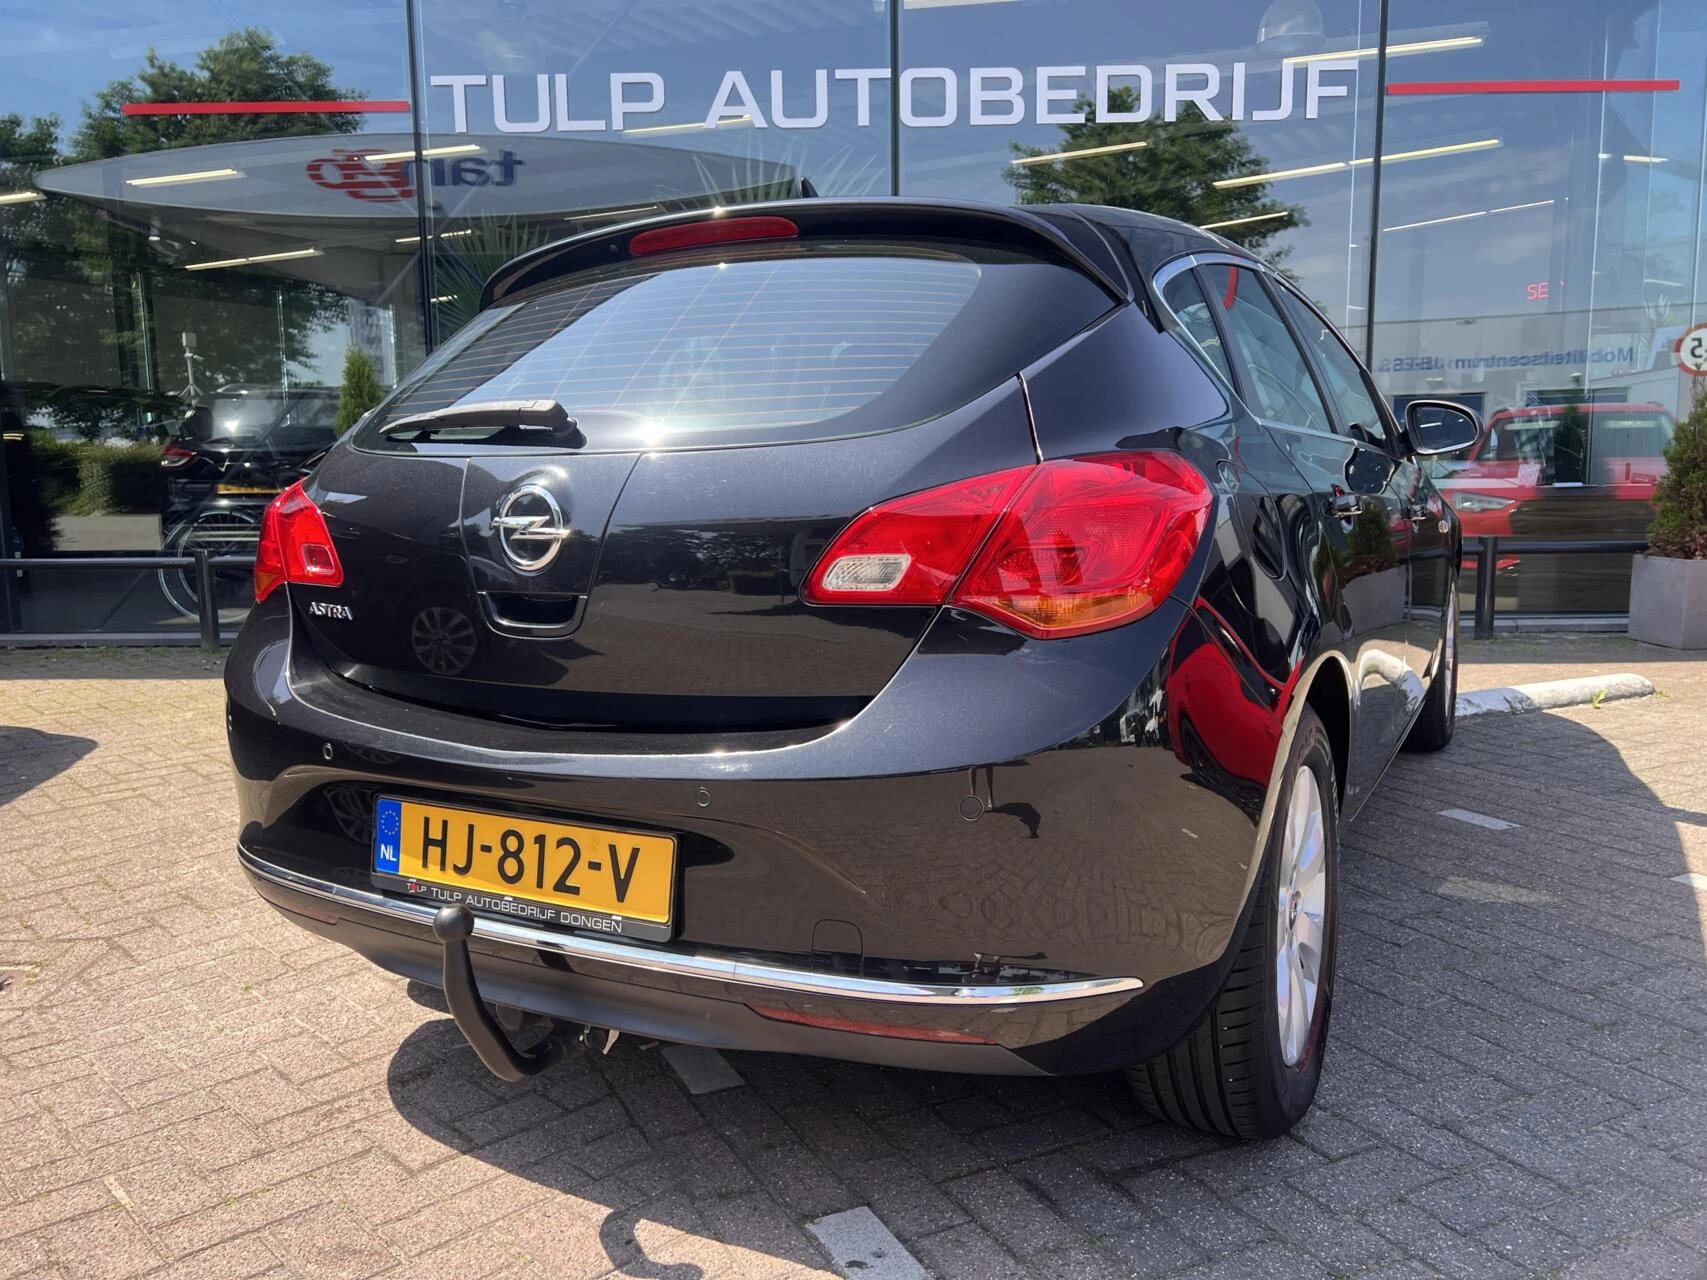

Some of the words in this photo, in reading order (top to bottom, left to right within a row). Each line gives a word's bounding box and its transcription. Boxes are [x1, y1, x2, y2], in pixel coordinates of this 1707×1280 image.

[430, 72, 665, 133] TULP
[703, 60, 1358, 129] AUTOBEDRIJF
[308, 601, 353, 620] ASTRA
[380, 843, 397, 862] NL
[422, 816, 641, 903] HJ-812-V
[431, 887, 462, 901] TULP
[465, 895, 557, 920] AUTOBEDRIJF
[561, 912, 622, 933] DONGEN
